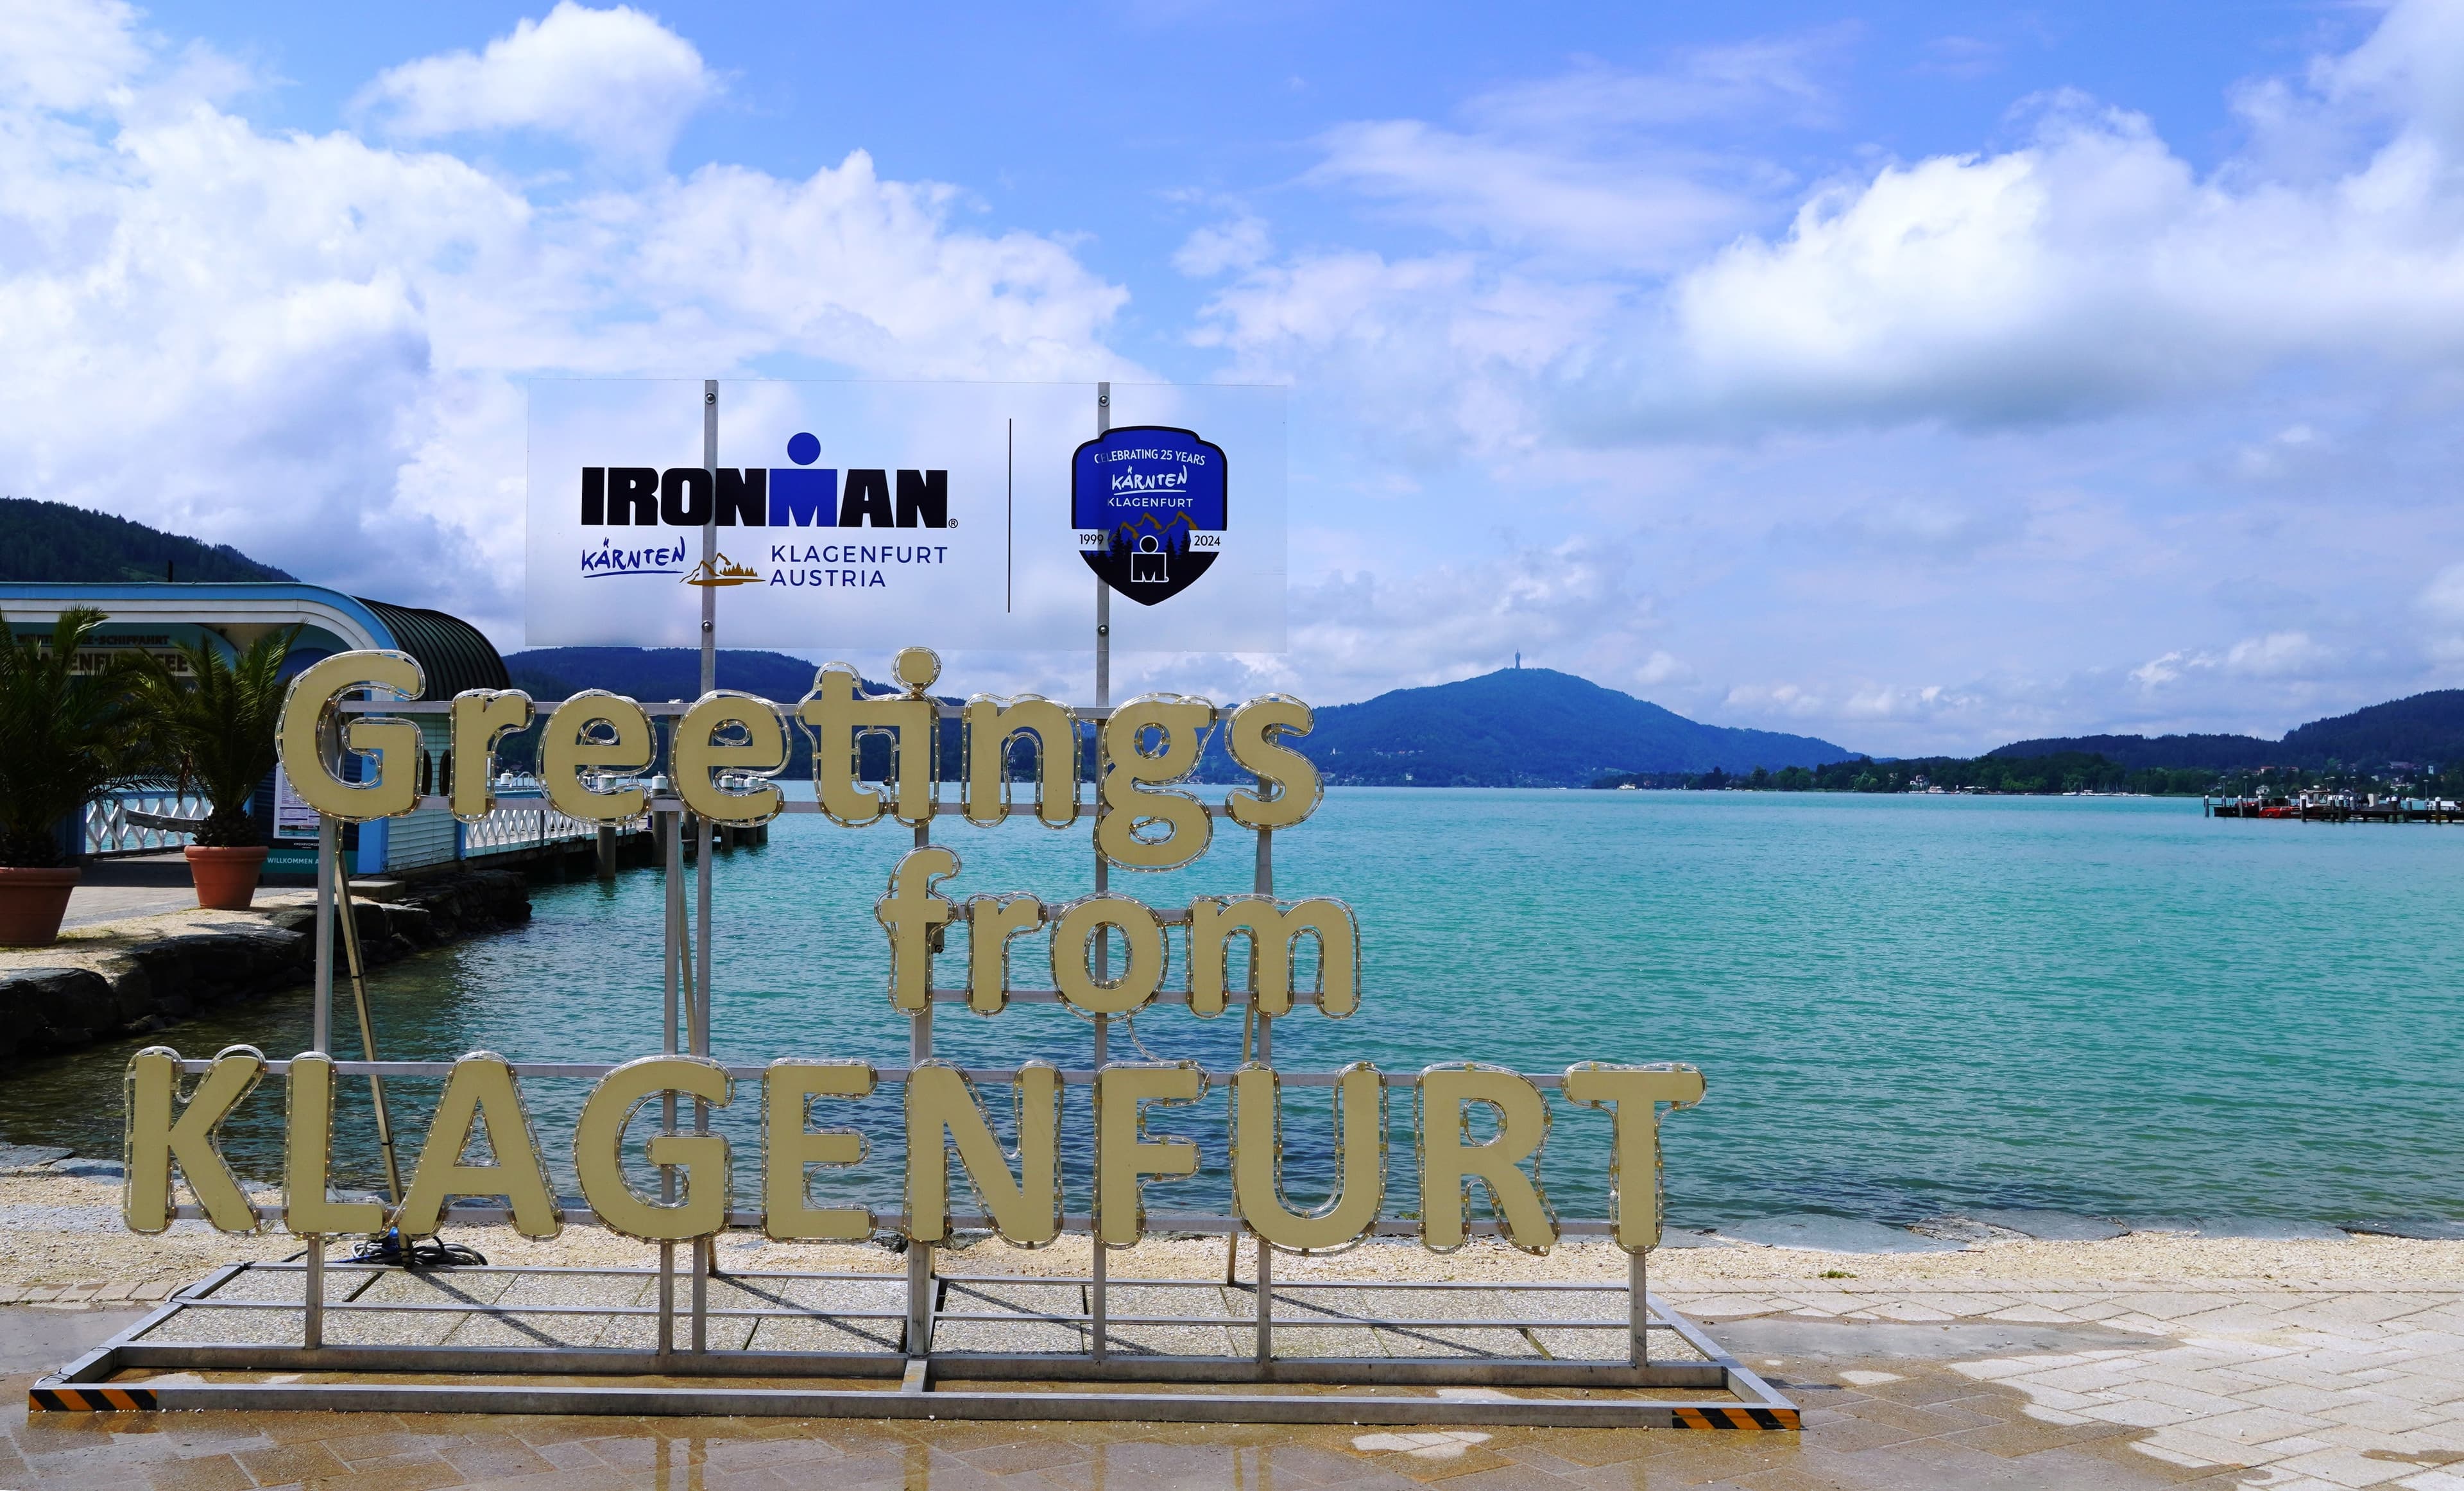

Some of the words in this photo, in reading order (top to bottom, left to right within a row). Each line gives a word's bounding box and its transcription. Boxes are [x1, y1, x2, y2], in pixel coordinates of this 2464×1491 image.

[1094, 449, 1158, 464] CELEBRATING
[1160, 449, 1173, 461] 25
[1176, 451, 1206, 466] YEARS
[1108, 497, 1194, 508] KLAGENFURT
[1079, 534, 1104, 545] 1999
[1194, 535, 1221, 547] 2024
[771, 544, 948, 564] KLAGENFURT
[770, 569, 886, 587] AUSTRIA
[276, 647, 1324, 872] Greetings
[874, 845, 1361, 1022] from
[122, 1044, 1707, 1257] KLAGENFURT
